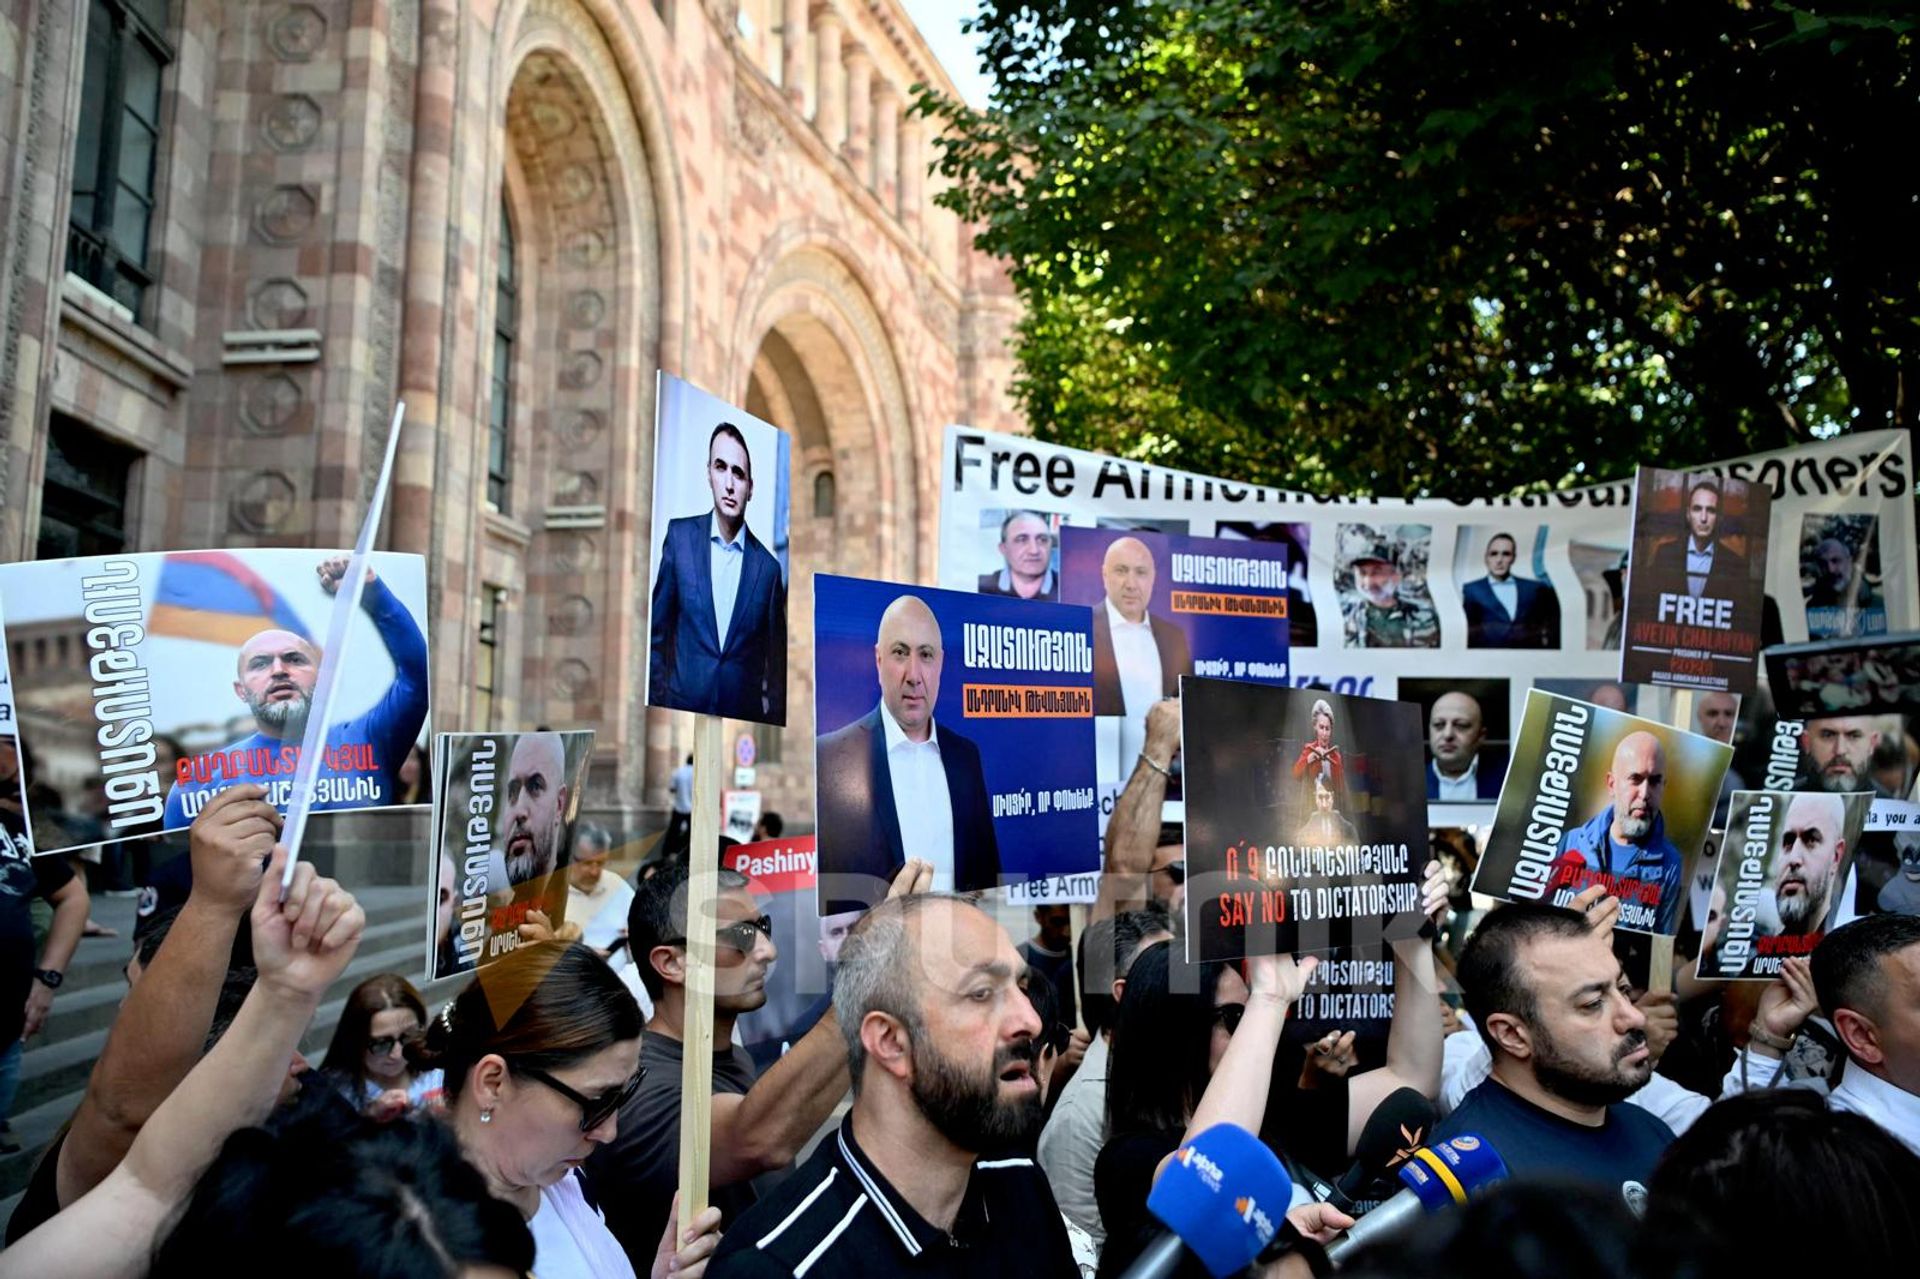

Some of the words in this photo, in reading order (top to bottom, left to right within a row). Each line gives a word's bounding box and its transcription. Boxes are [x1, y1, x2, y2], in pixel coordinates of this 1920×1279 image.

[955, 435, 1074, 497] Free
[1658, 592, 1734, 630] FREE
[963, 623, 1092, 673] ԱԶԱՏՈՒԹՅՈՒՆ
[81, 560, 164, 829] ԱԶԱՏՈՒԹՅՈՒՆ
[1508, 704, 1588, 900] ԱԶԱՏՈՒԹՅՈՒՆ
[1886, 813, 1907, 826] you
[458, 739, 497, 965] ԱԶԱՏՈՒԹՅՈՒՆ
[1056, 876, 1101, 897] Arm
[1219, 891, 1255, 928] SAY
[1262, 890, 1286, 924] NO
[1290, 888, 1311, 921] TO
[1317, 882, 1418, 920] DICTATORSHIP
[1719, 796, 1773, 972] ԱԶԱՏՈՒԹՅՈՒՆ
